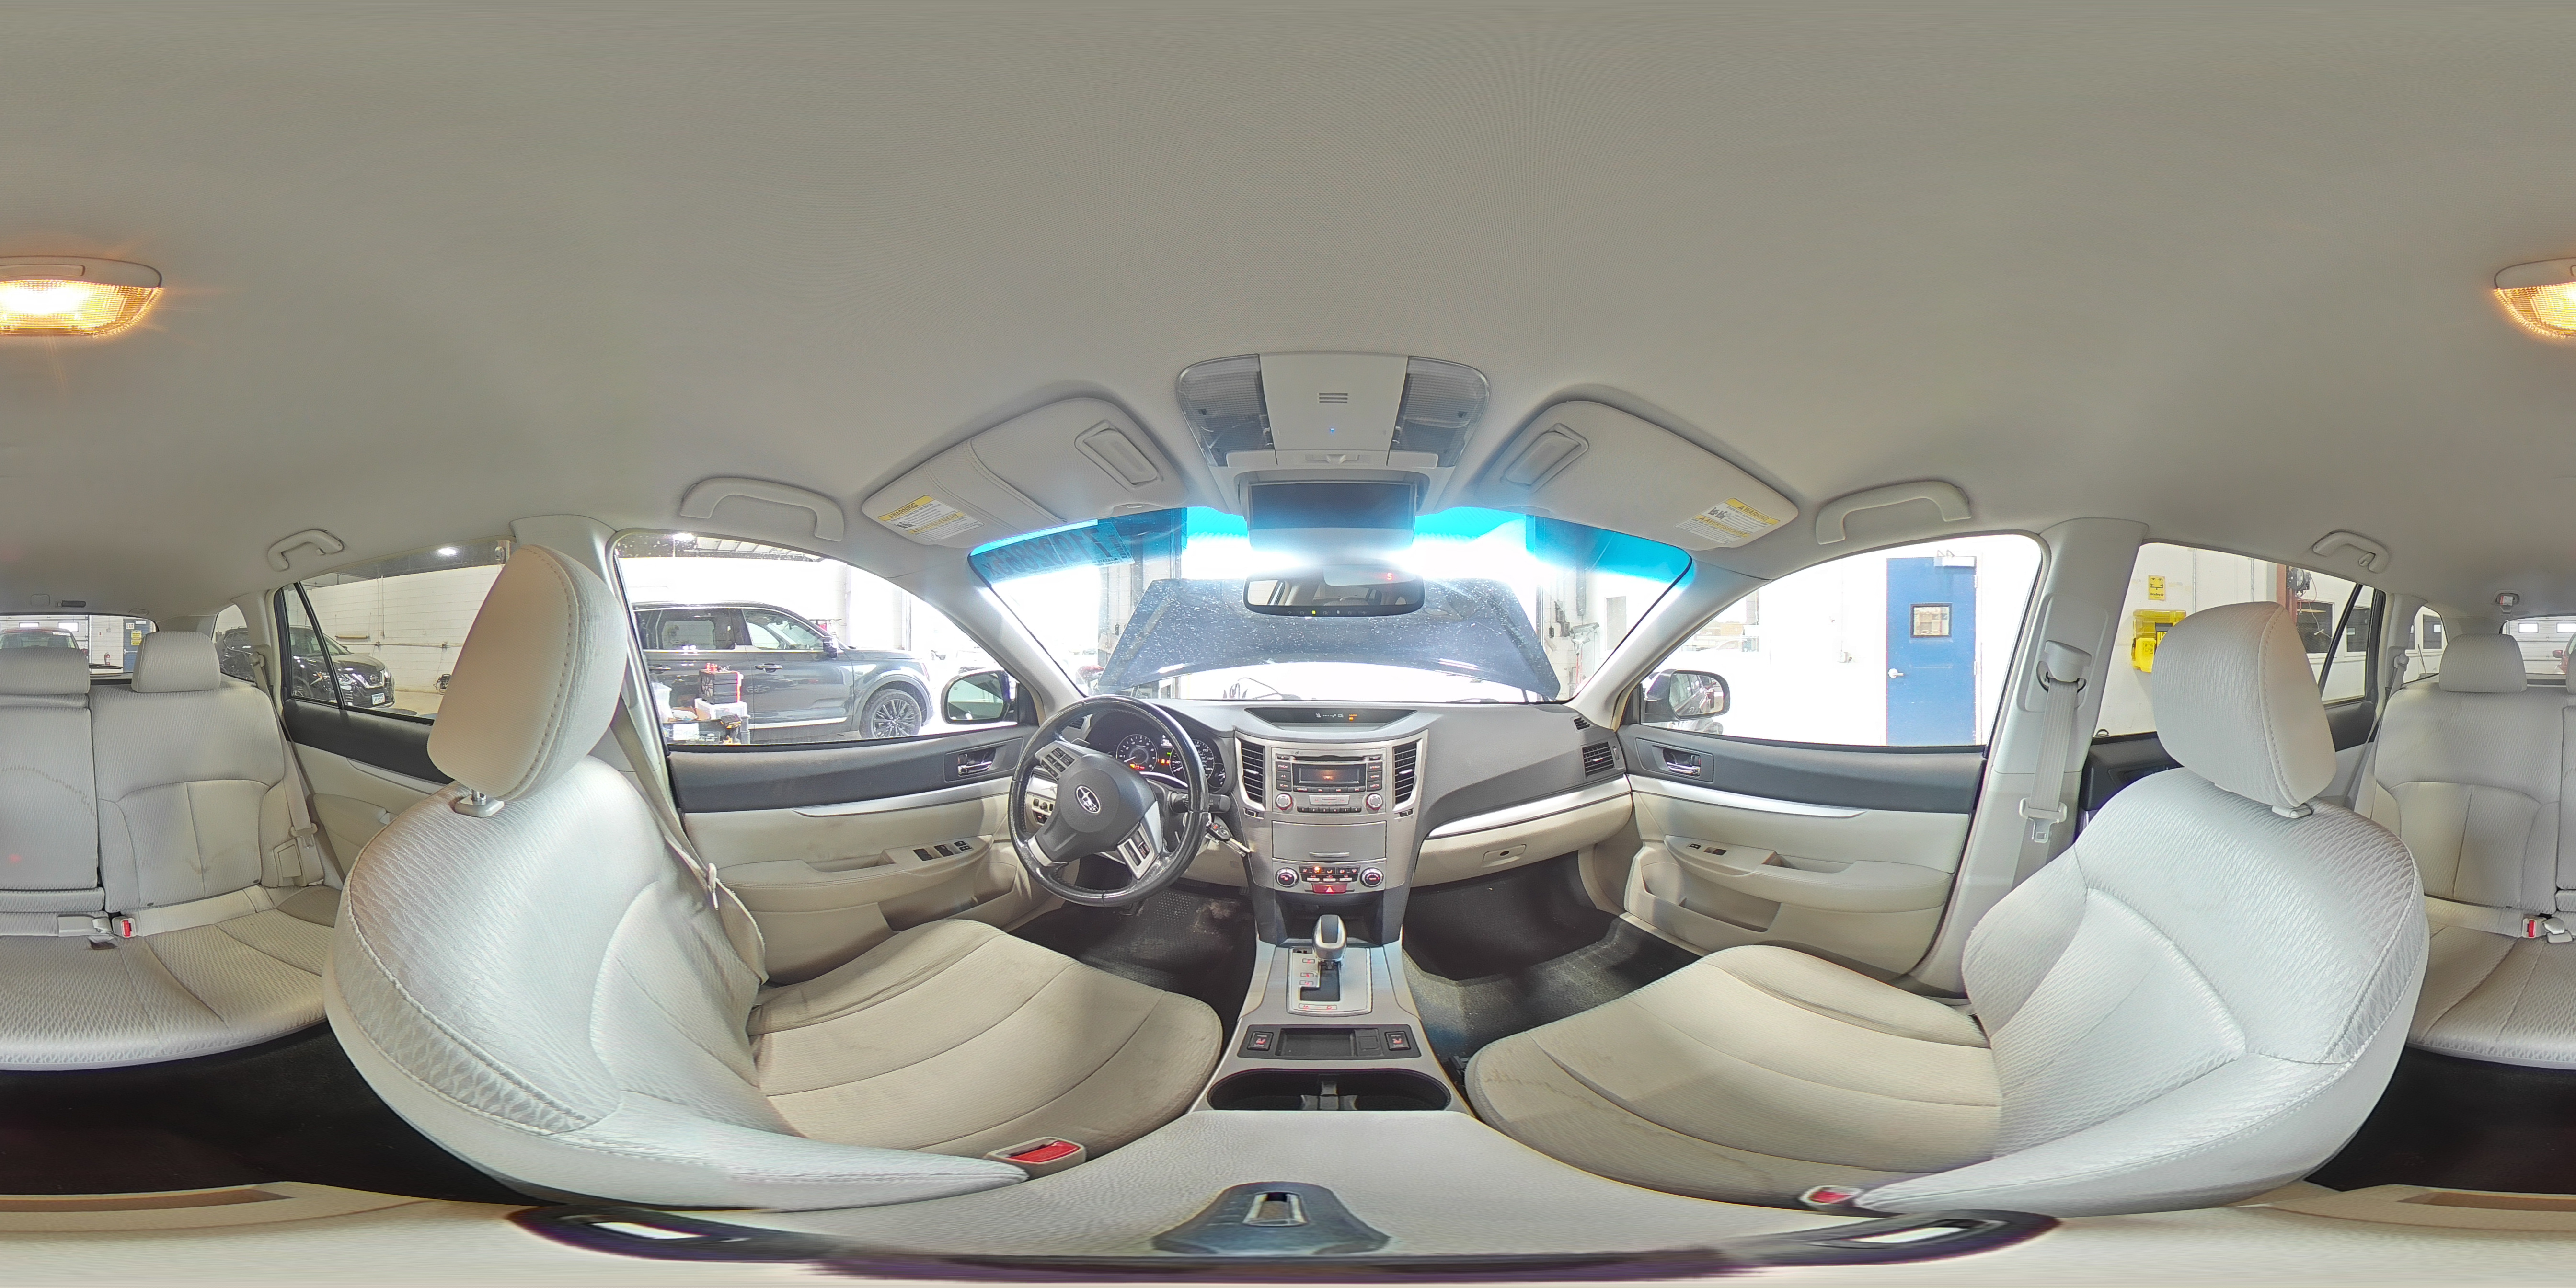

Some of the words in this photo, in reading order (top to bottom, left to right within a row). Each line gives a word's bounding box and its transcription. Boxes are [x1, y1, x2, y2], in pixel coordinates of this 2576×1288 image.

[891, 503, 919, 517] WARNING
[1743, 507, 1770, 521] WARNING
[917, 514, 959, 531] AVERTISSEMENT
[1705, 518, 1748, 536] AVERTISSEMENT
